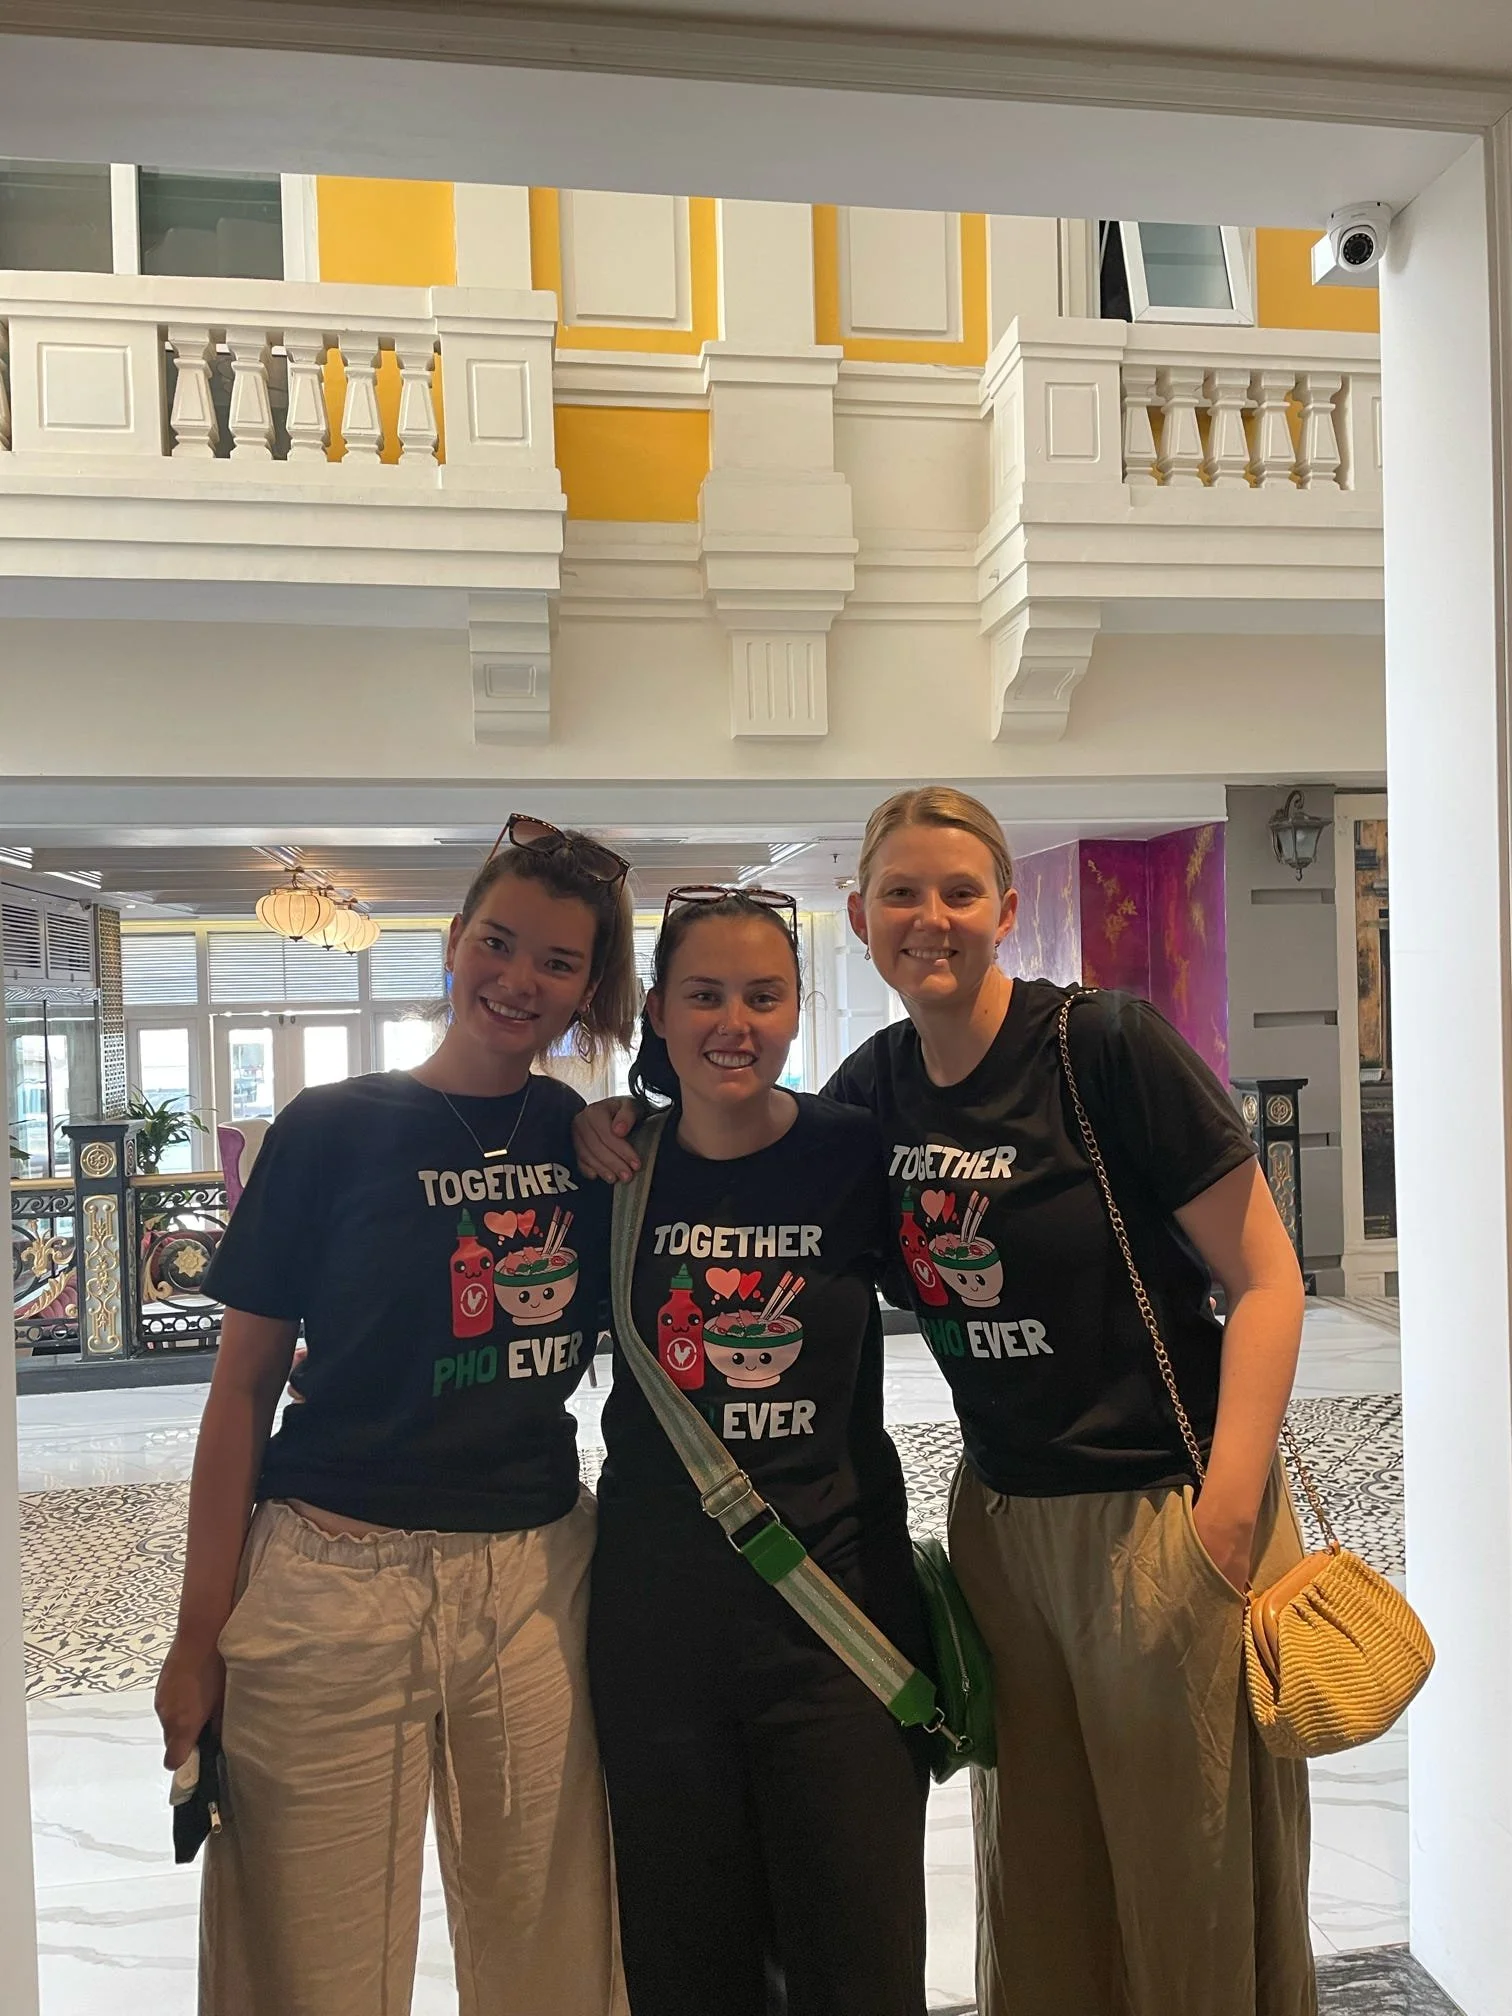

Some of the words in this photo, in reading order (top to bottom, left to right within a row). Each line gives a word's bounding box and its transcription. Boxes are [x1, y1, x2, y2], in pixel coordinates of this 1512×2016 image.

[888, 1144, 1017, 1181] TOGETHER
[418, 1163, 579, 1206] TOGETHER
[653, 1221, 823, 1258] TOGETHER
[966, 1318, 1054, 1359] EVER
[432, 1345, 498, 1397] PHO
[508, 1331, 583, 1379] EVER
[723, 1399, 817, 1440] EVER
